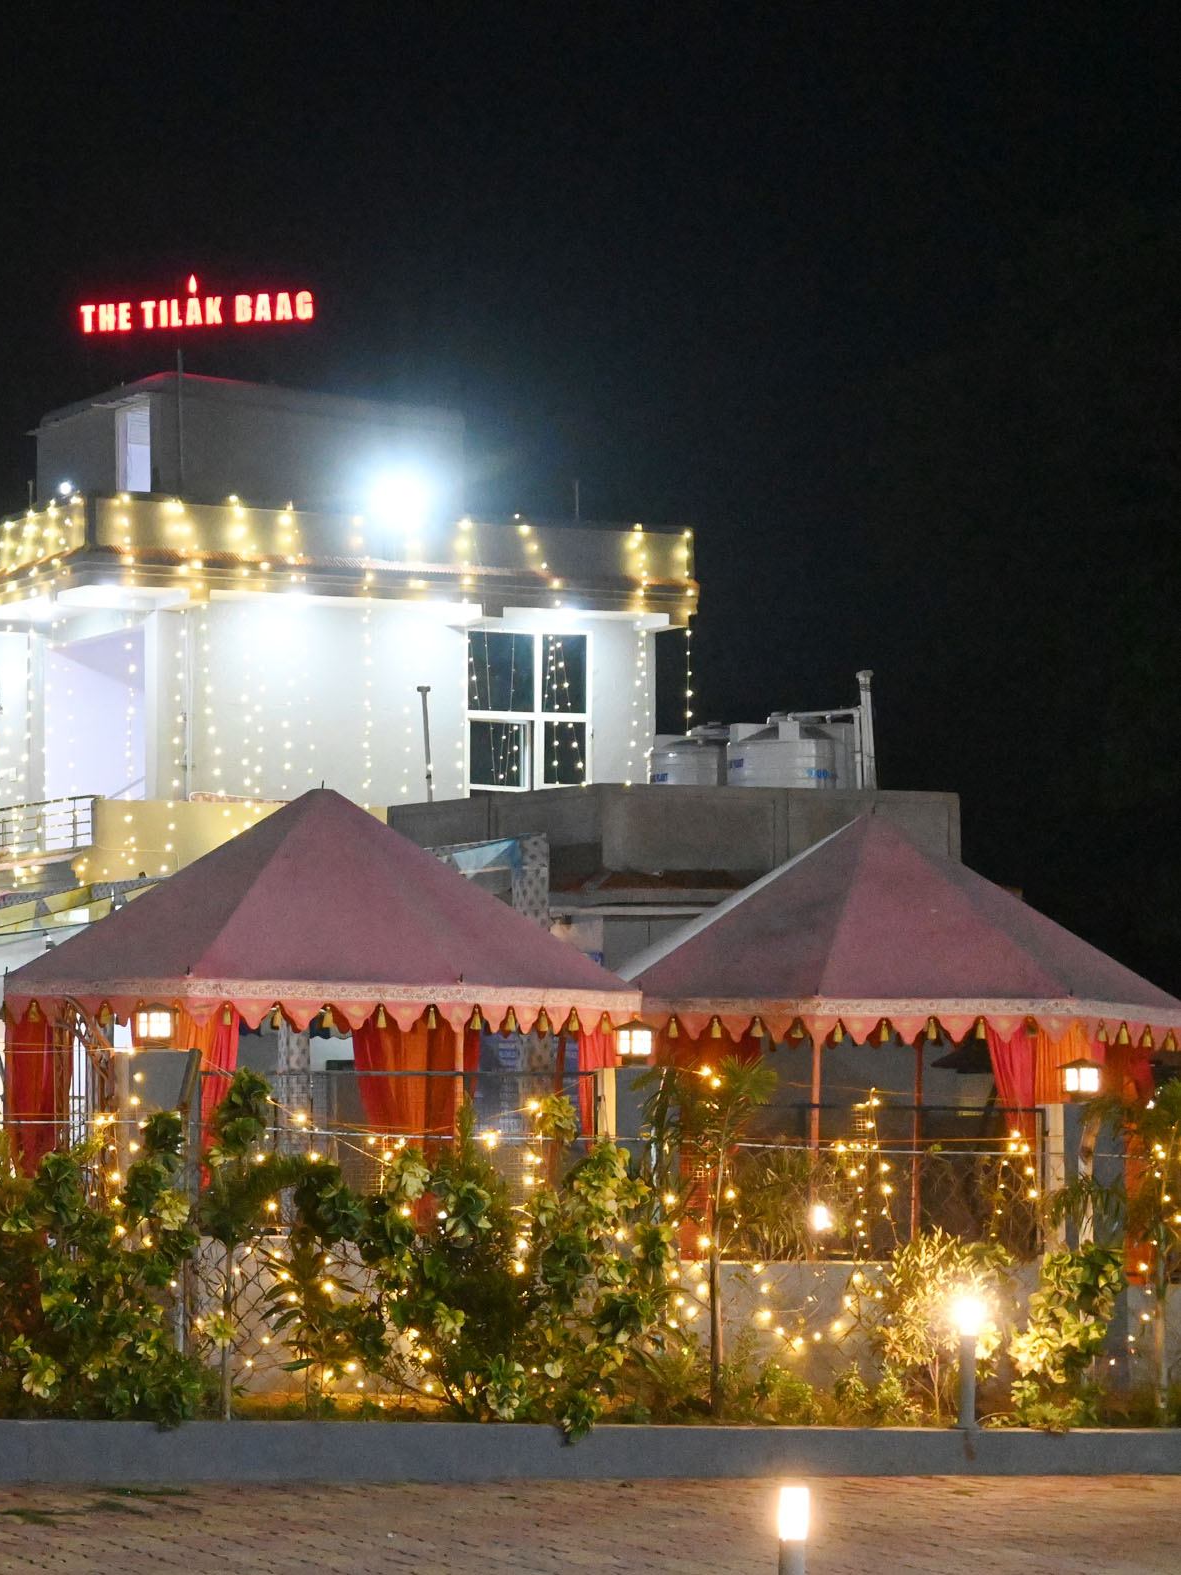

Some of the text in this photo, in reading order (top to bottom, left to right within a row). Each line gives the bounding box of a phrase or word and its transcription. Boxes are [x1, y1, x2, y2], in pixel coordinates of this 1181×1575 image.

[80, 290, 314, 333] THE TILAK BAAG
